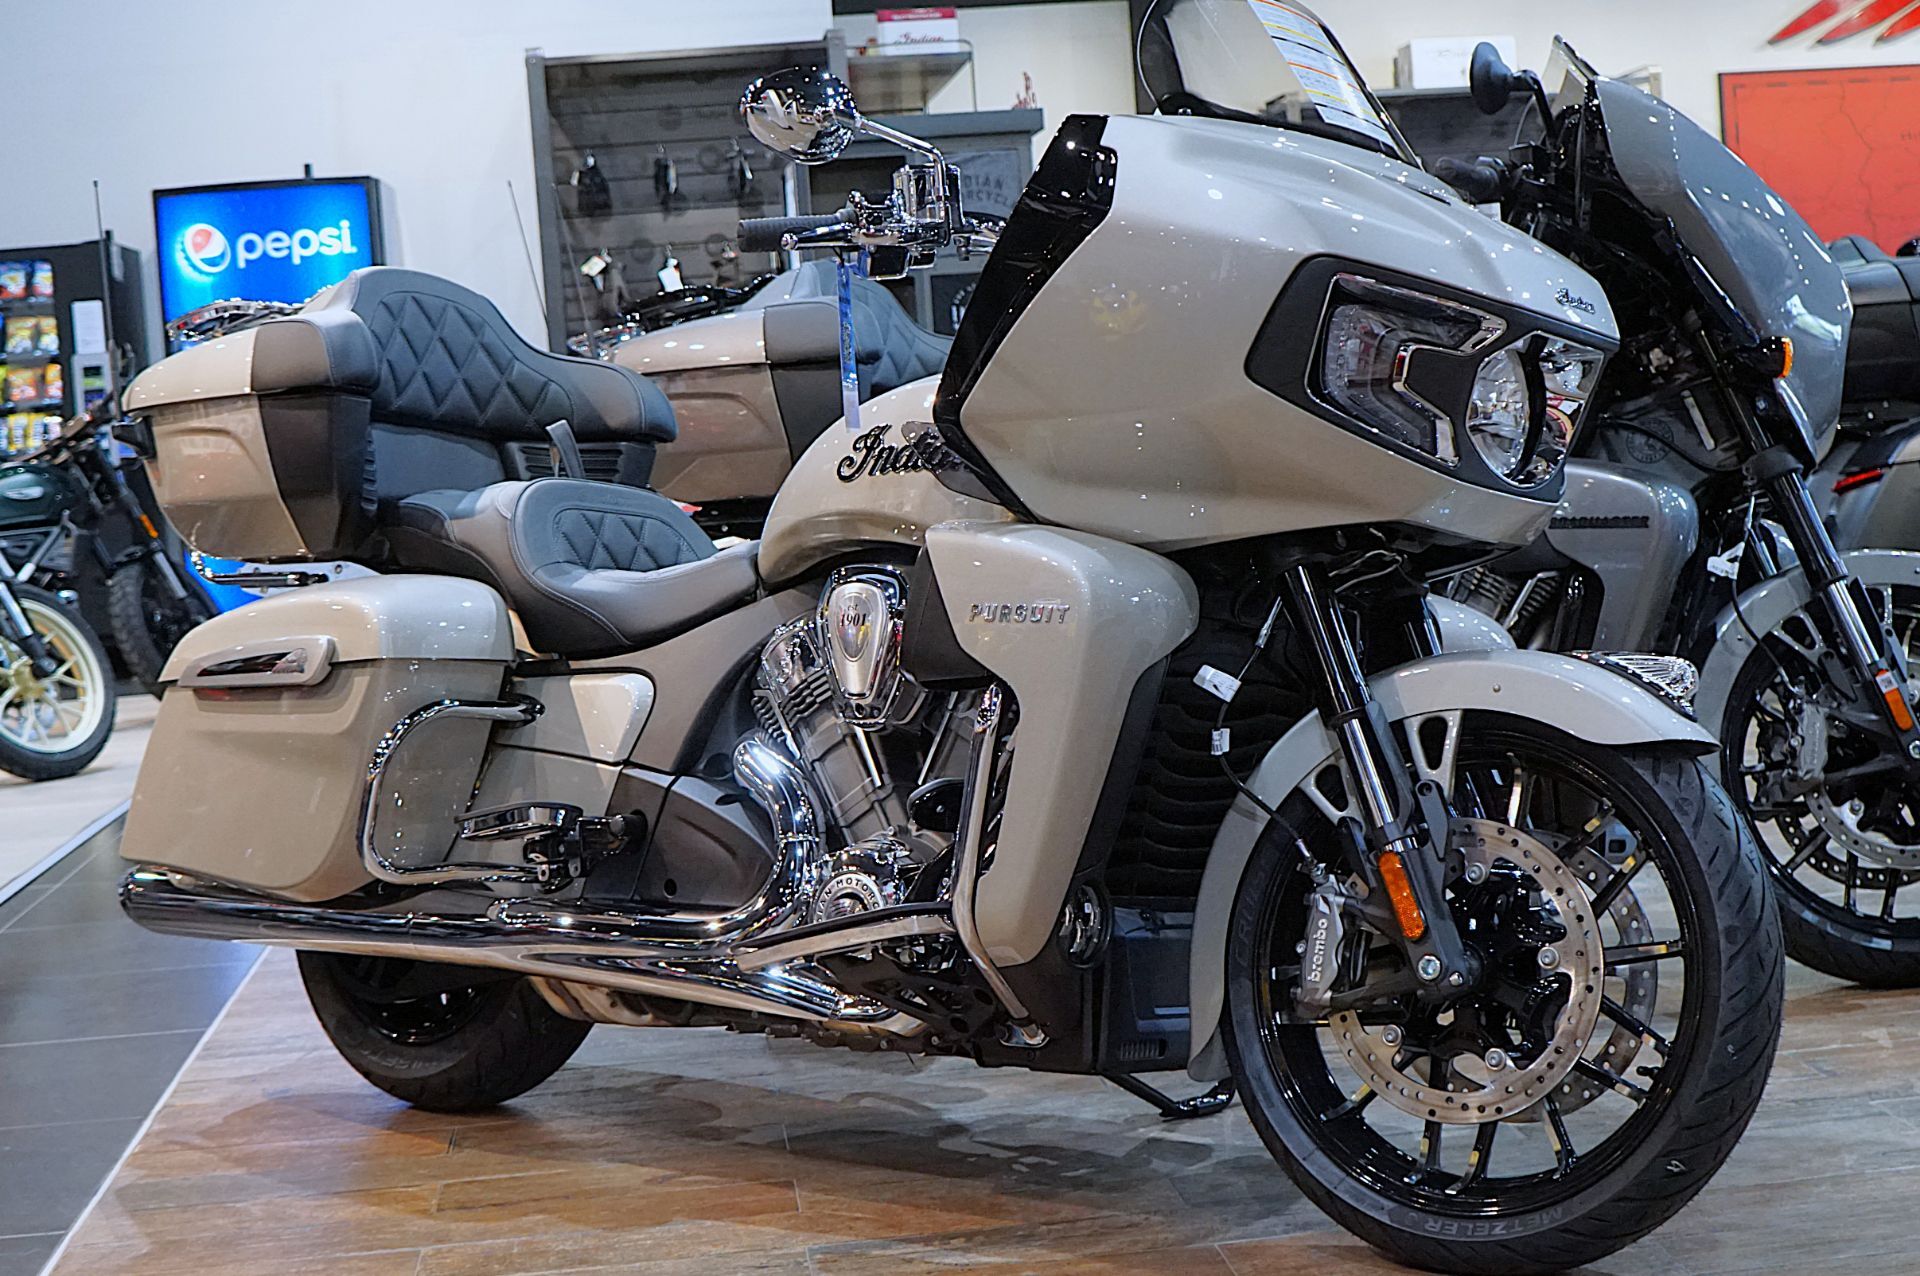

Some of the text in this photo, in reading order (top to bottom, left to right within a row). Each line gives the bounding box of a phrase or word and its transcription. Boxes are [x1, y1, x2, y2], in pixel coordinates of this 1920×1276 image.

[963, 174, 1006, 191] DIAN
[237, 219, 353, 269] pepsi
[840, 613, 867, 627] 1901
[968, 603, 1071, 624] PURSUIT
[835, 877, 881, 908] MOTORC
[1307, 918, 1328, 982] brembo
[1423, 1207, 1564, 1237] METZELER
